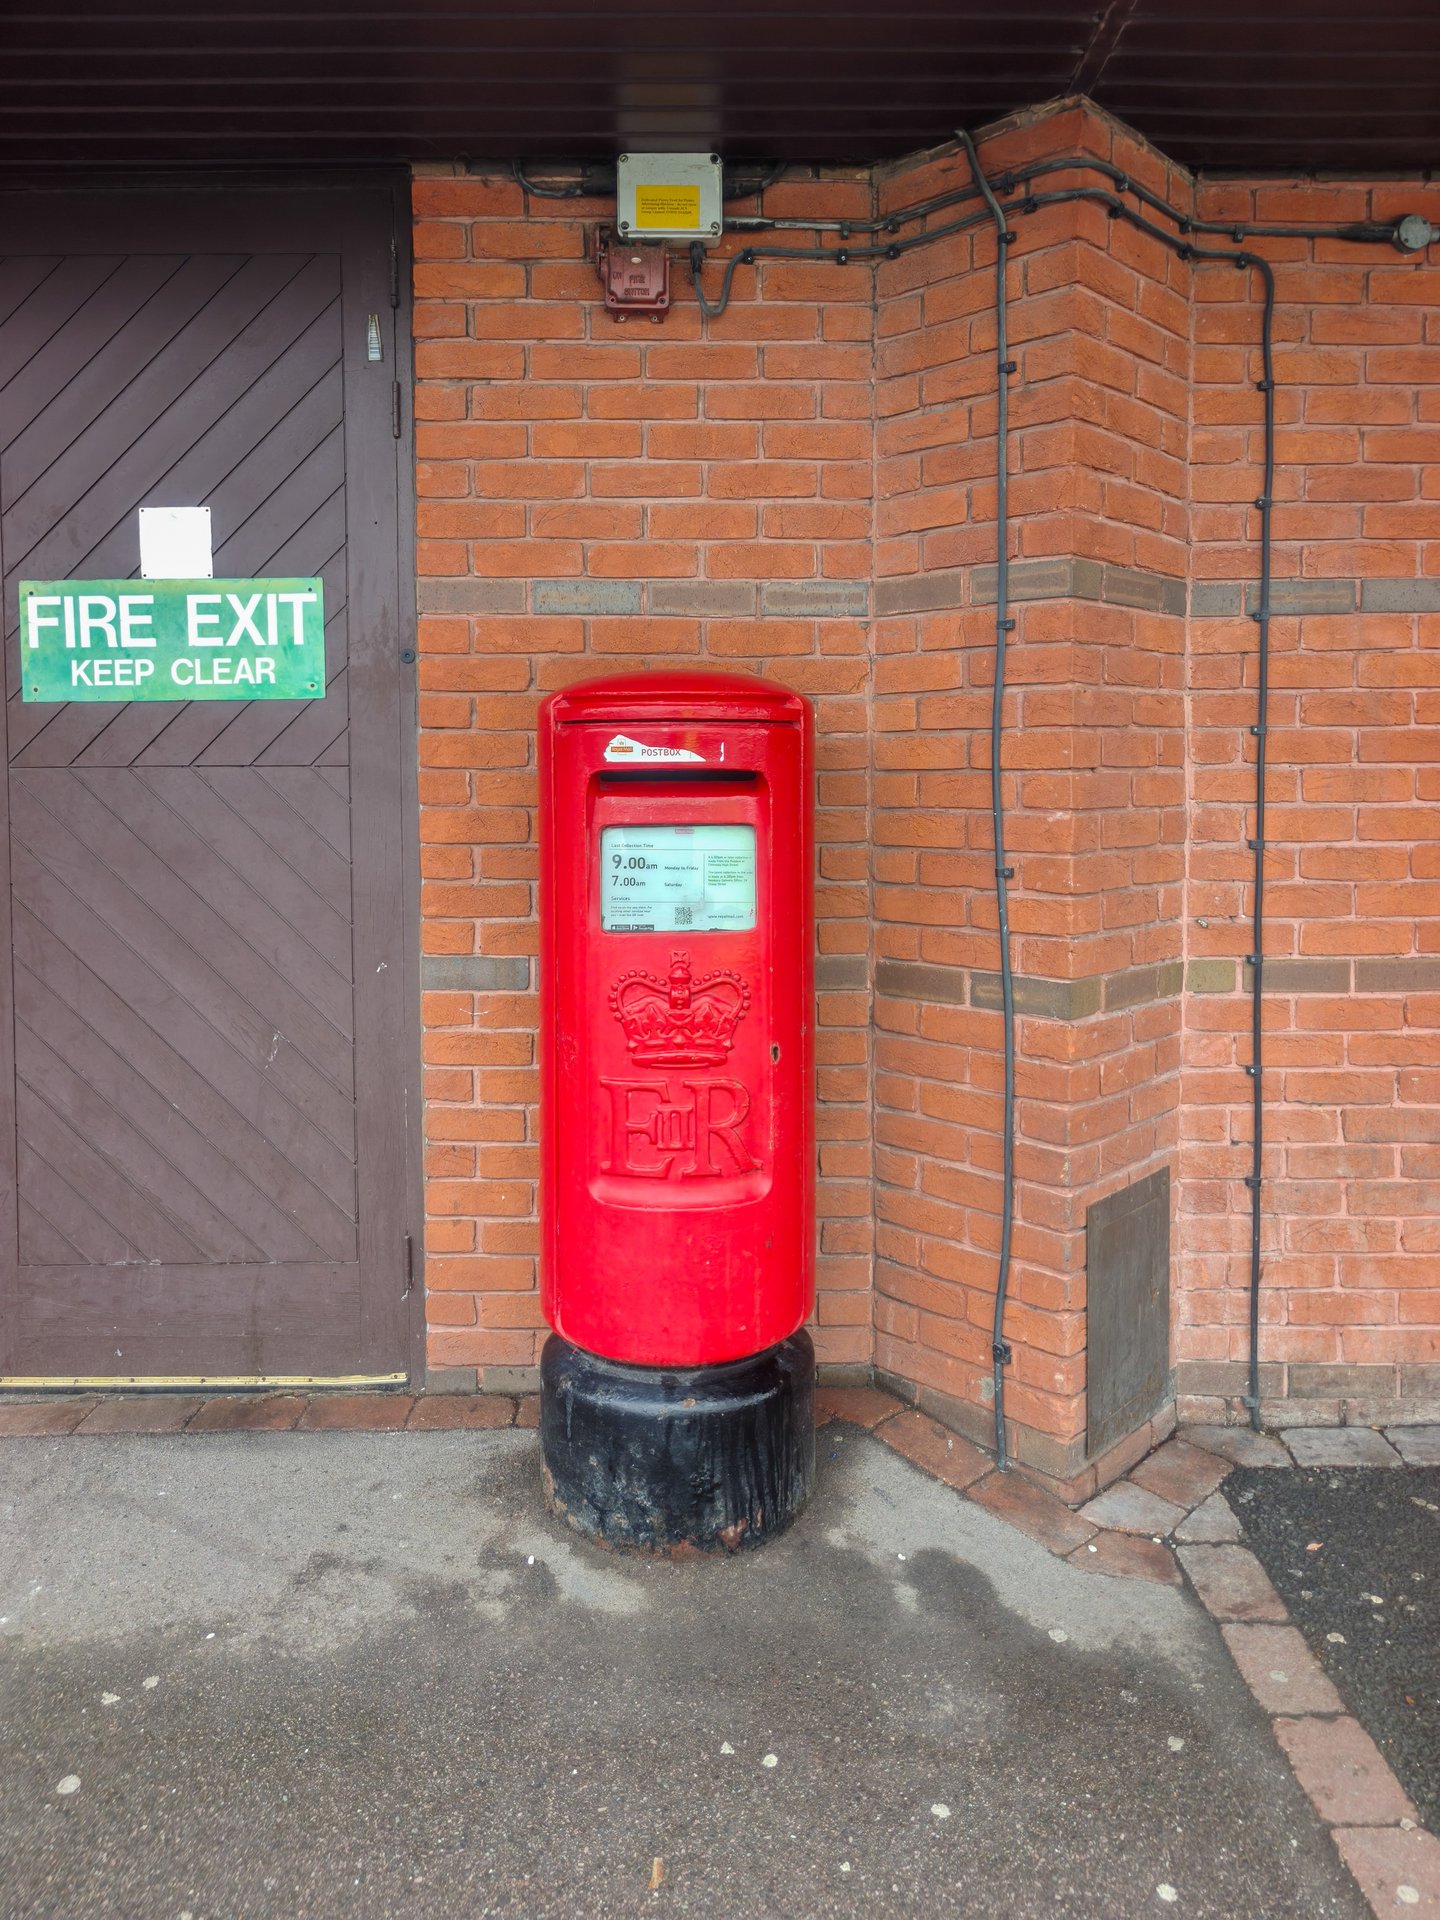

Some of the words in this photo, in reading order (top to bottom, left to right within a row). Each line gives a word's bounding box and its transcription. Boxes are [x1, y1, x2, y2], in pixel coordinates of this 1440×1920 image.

[27, 595, 157, 648] FIRE
[186, 593, 317, 647] EXIT
[71, 658, 155, 686] KEEP
[170, 657, 276, 685] CLEAR
[641, 748, 681, 756] POSTBOX
[612, 854, 658, 870] 9.00am
[612, 875, 646, 887] 7.00am
